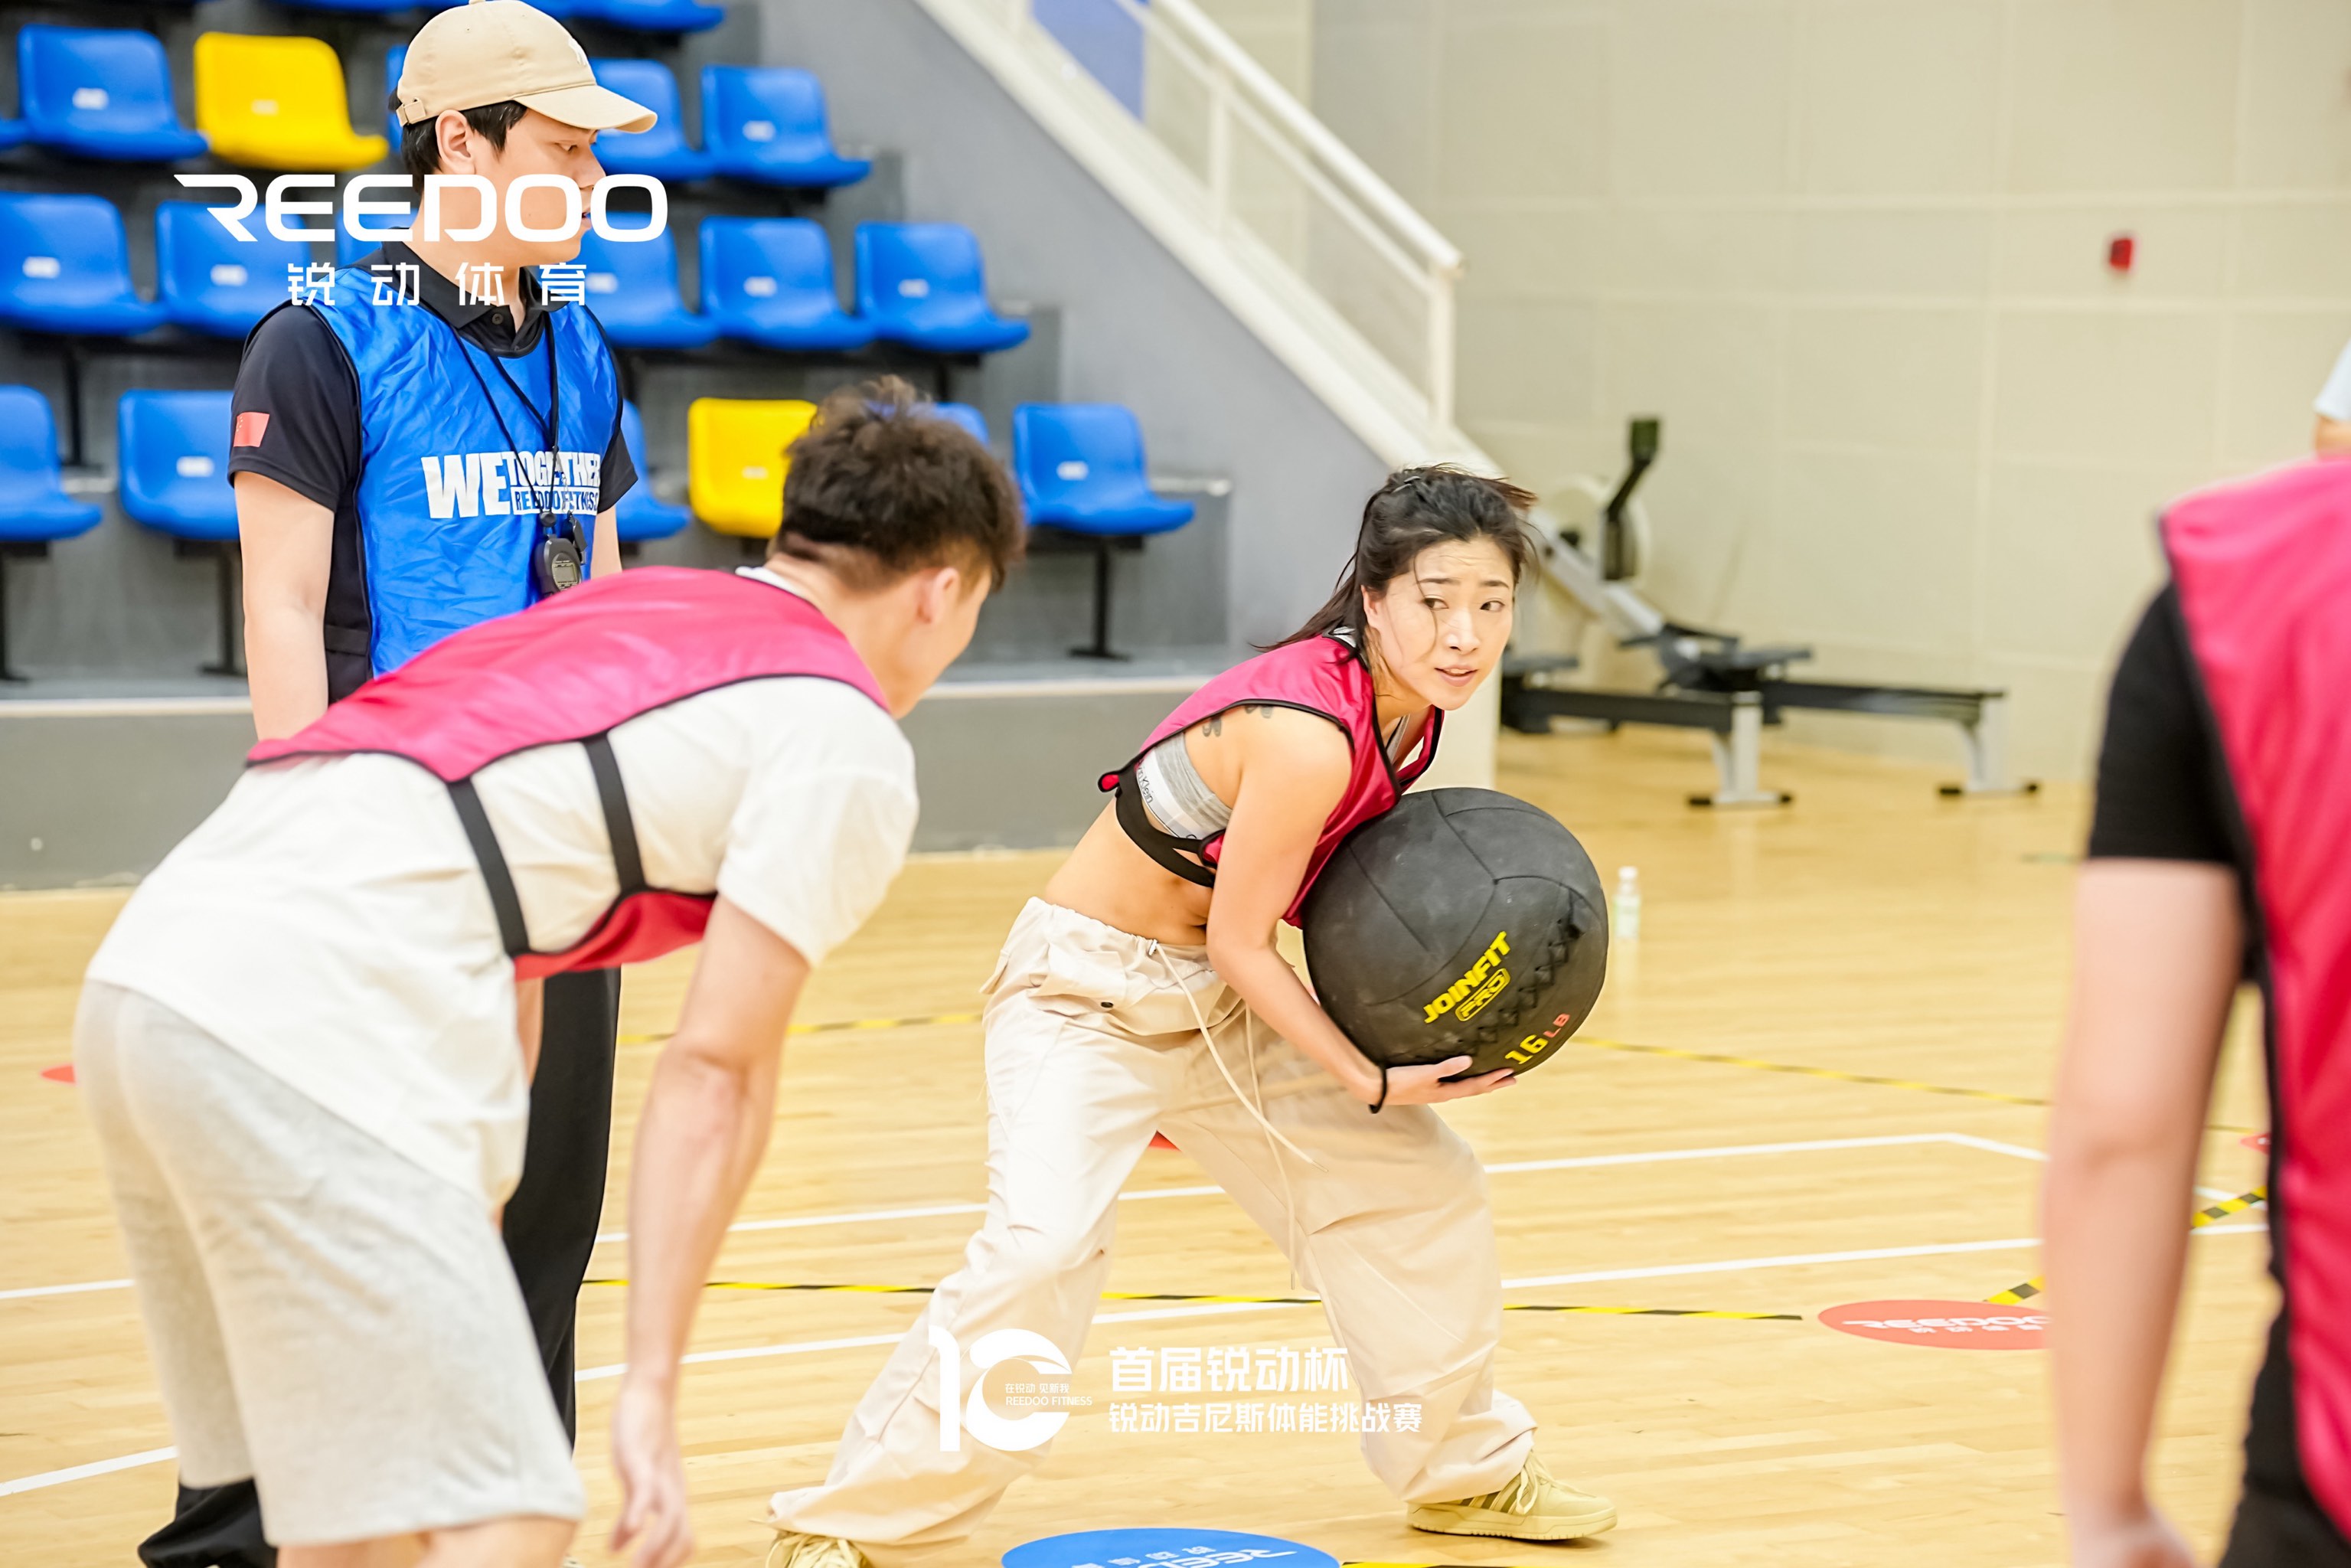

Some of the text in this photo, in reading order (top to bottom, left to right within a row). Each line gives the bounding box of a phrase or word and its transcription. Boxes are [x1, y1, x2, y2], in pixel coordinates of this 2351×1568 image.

[421, 450, 601, 518] WE TOGETHER
[1423, 931, 1511, 1024] JOINFIT
[1461, 973, 1507, 1018] PRO
[1505, 1013, 1570, 1064] 16 LB
